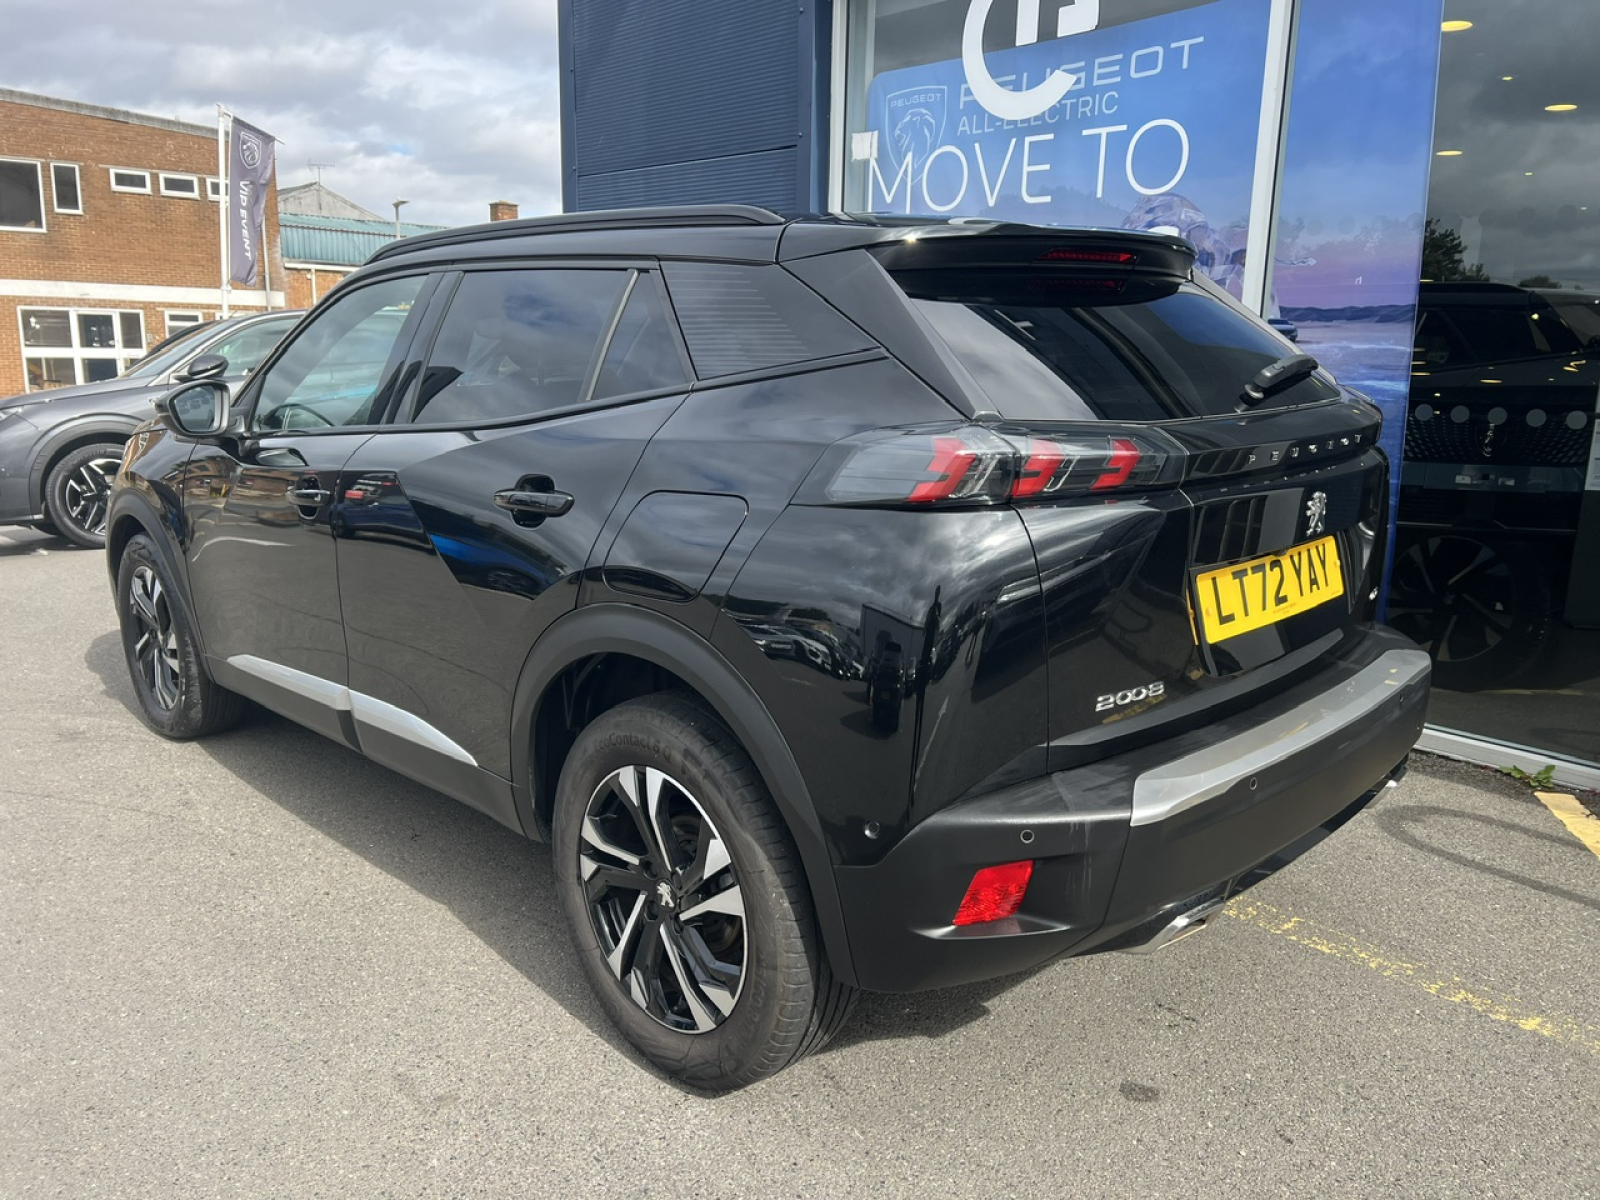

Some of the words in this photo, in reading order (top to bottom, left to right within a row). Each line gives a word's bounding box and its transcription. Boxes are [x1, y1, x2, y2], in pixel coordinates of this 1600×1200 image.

[890, 93, 942, 107] PEUGEOT
[867, 133, 1054, 214] MOVE
[1081, 118, 1190, 199] TO
[239, 181, 251, 206] VIP
[239, 208, 252, 260] EVENT
[1248, 434, 1362, 464] PEUGEOT
[1211, 559, 1289, 625] LT72
[1290, 542, 1329, 597] YAY
[1095, 681, 1165, 712] 2008
